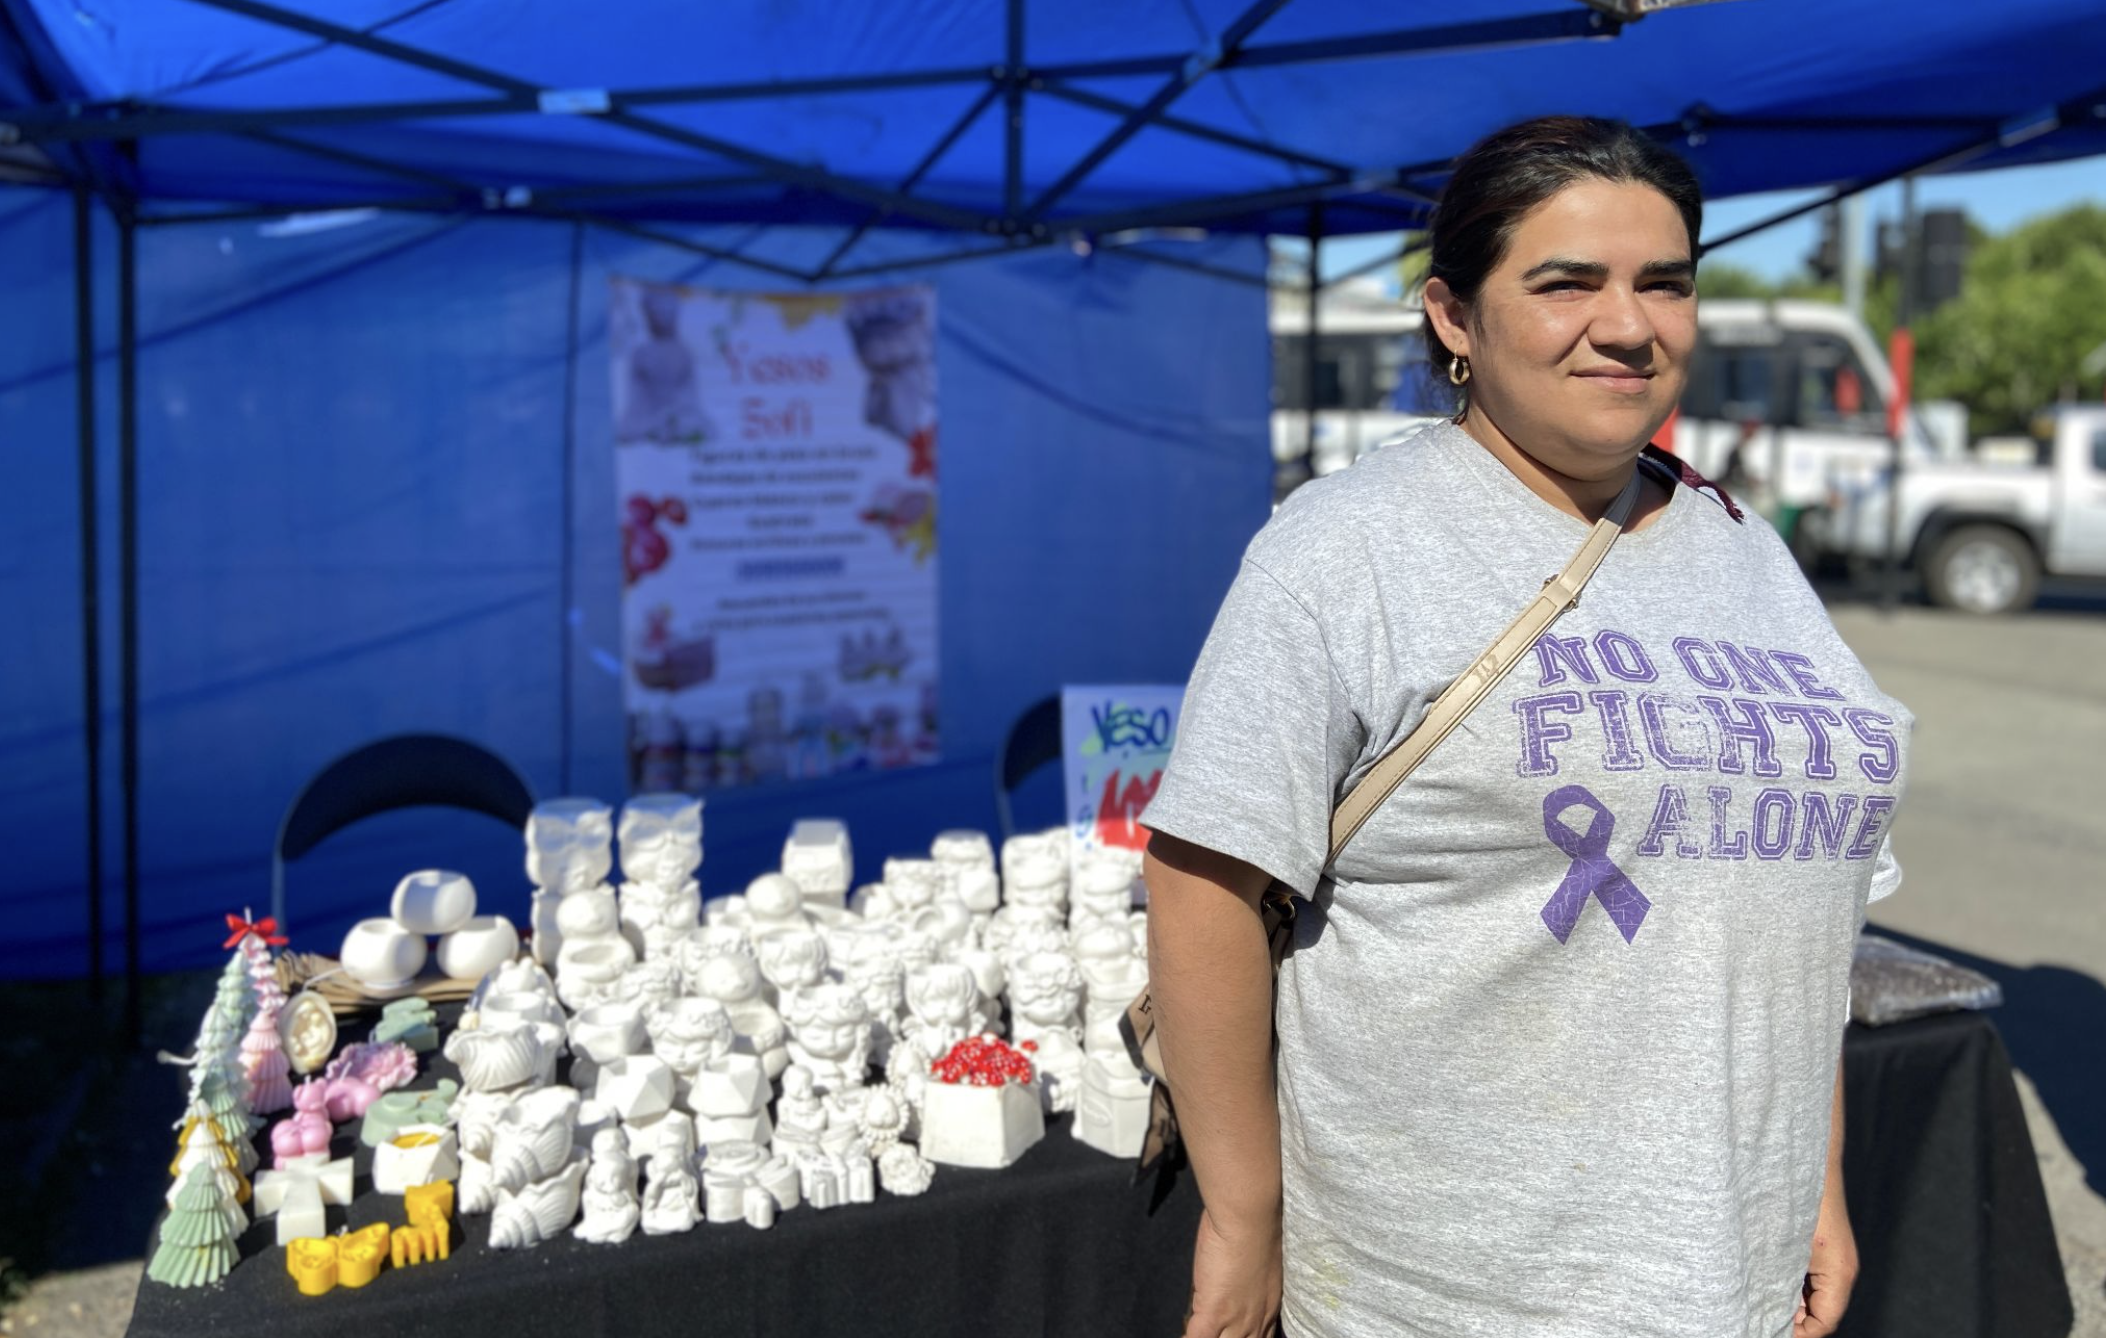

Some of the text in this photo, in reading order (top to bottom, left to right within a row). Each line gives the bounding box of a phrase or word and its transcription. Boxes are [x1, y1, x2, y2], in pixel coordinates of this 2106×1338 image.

[1533, 629, 1846, 702] NO ONE
[1512, 689, 1900, 785] FIGHTS
[1637, 783, 1898, 861] ALONE
